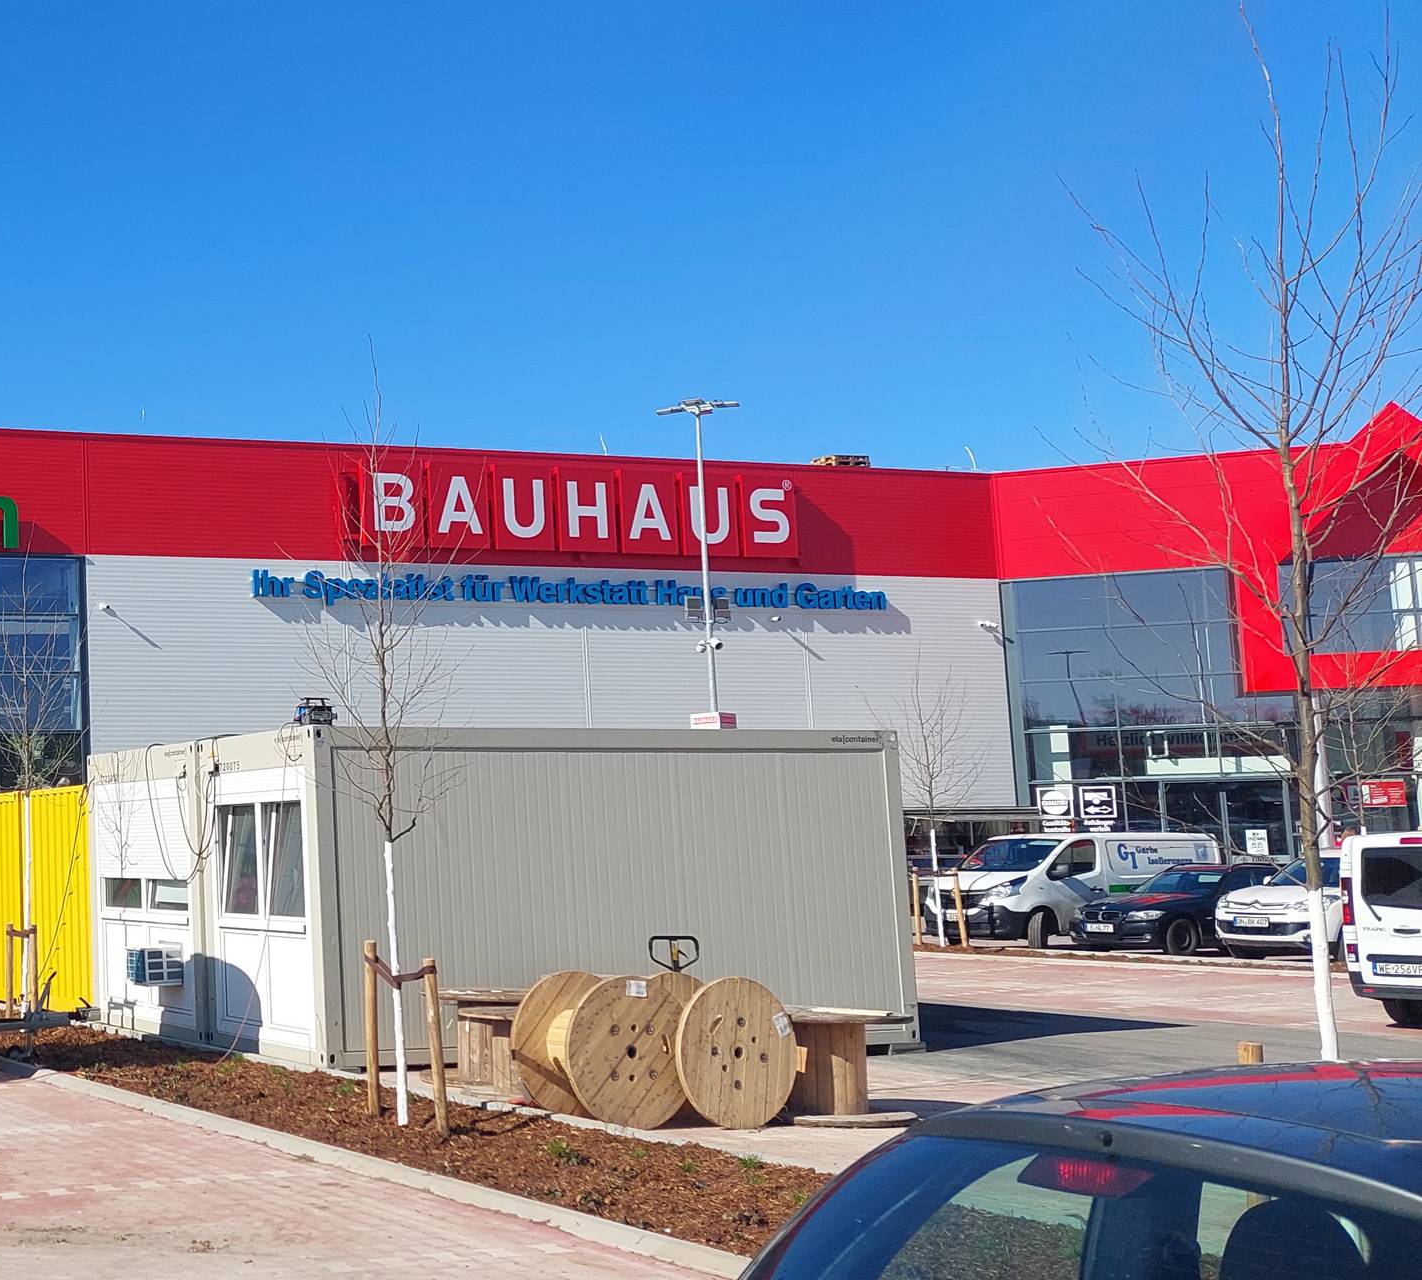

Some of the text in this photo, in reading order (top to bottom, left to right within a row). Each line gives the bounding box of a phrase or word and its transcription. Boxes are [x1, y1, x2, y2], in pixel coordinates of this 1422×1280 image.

[252, 569, 295, 598] Ihr
[461, 573, 506, 602] für
[509, 575, 648, 605] Werkstatt
[734, 582, 790, 609] und
[795, 583, 888, 611] Garten
